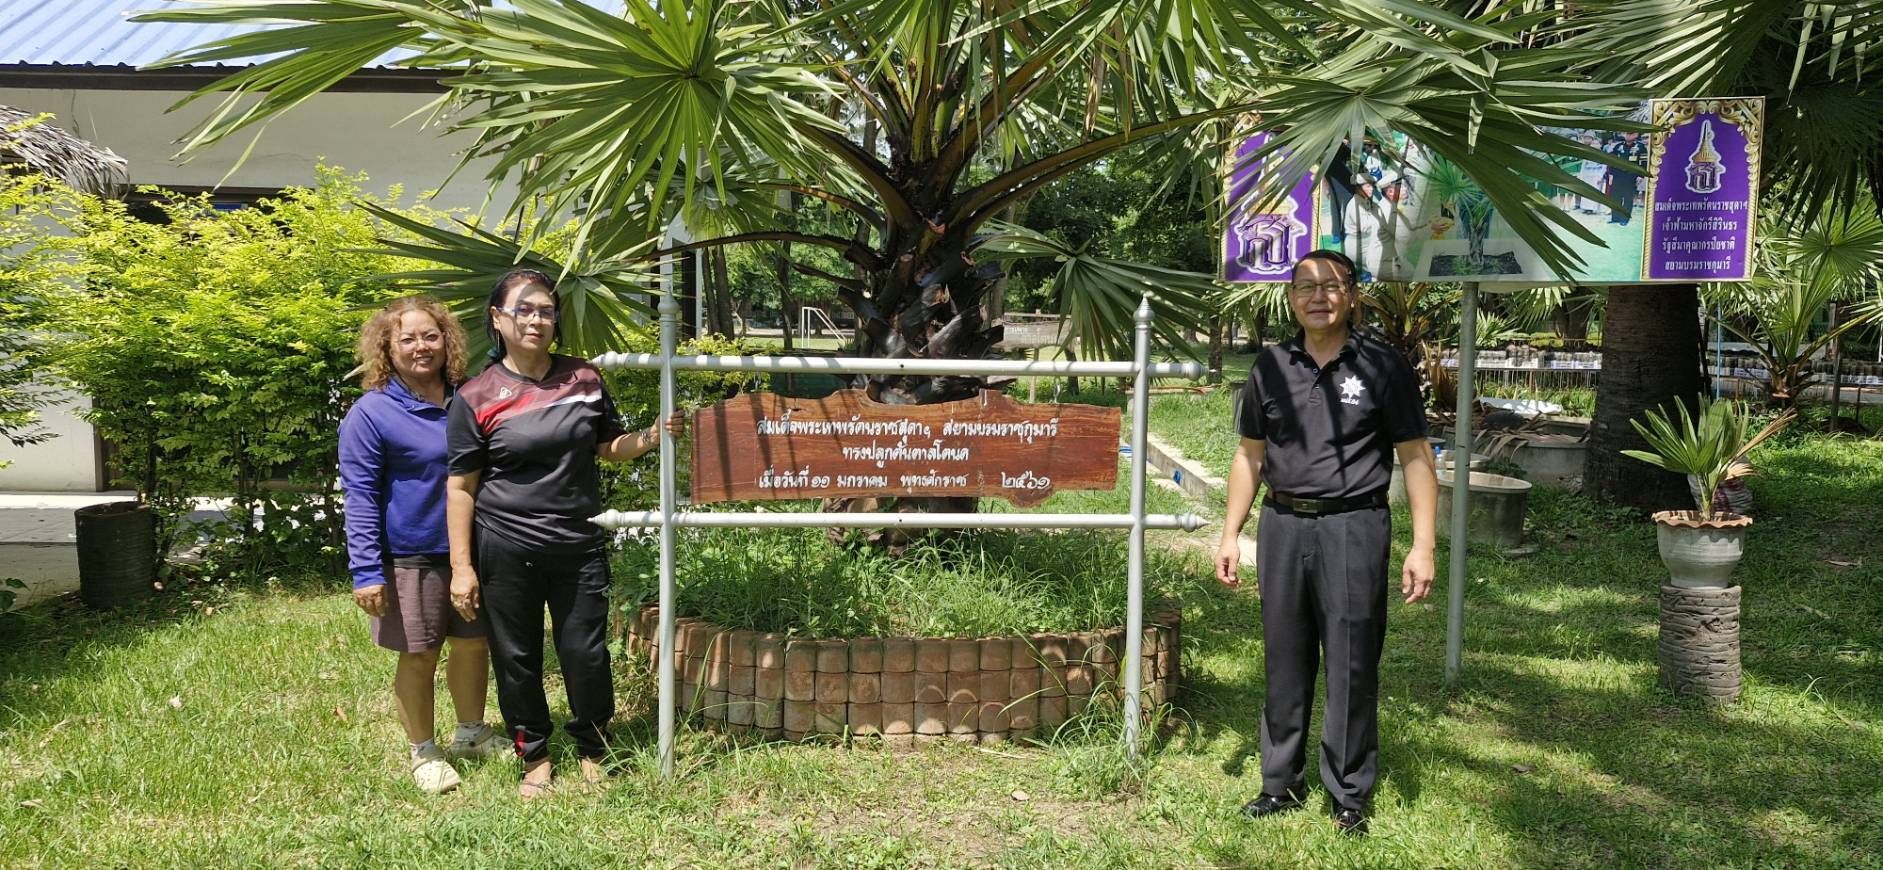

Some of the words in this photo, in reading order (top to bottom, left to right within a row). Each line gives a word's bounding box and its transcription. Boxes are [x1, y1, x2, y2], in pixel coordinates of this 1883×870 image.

[842, 439, 969, 468] ทรงปลูกต้นตาลโตนด
[837, 475, 888, 488] มกราคม
[900, 469, 969, 494] พุทธศักราช
[1001, 470, 1051, 489] ๒๕๖๑
